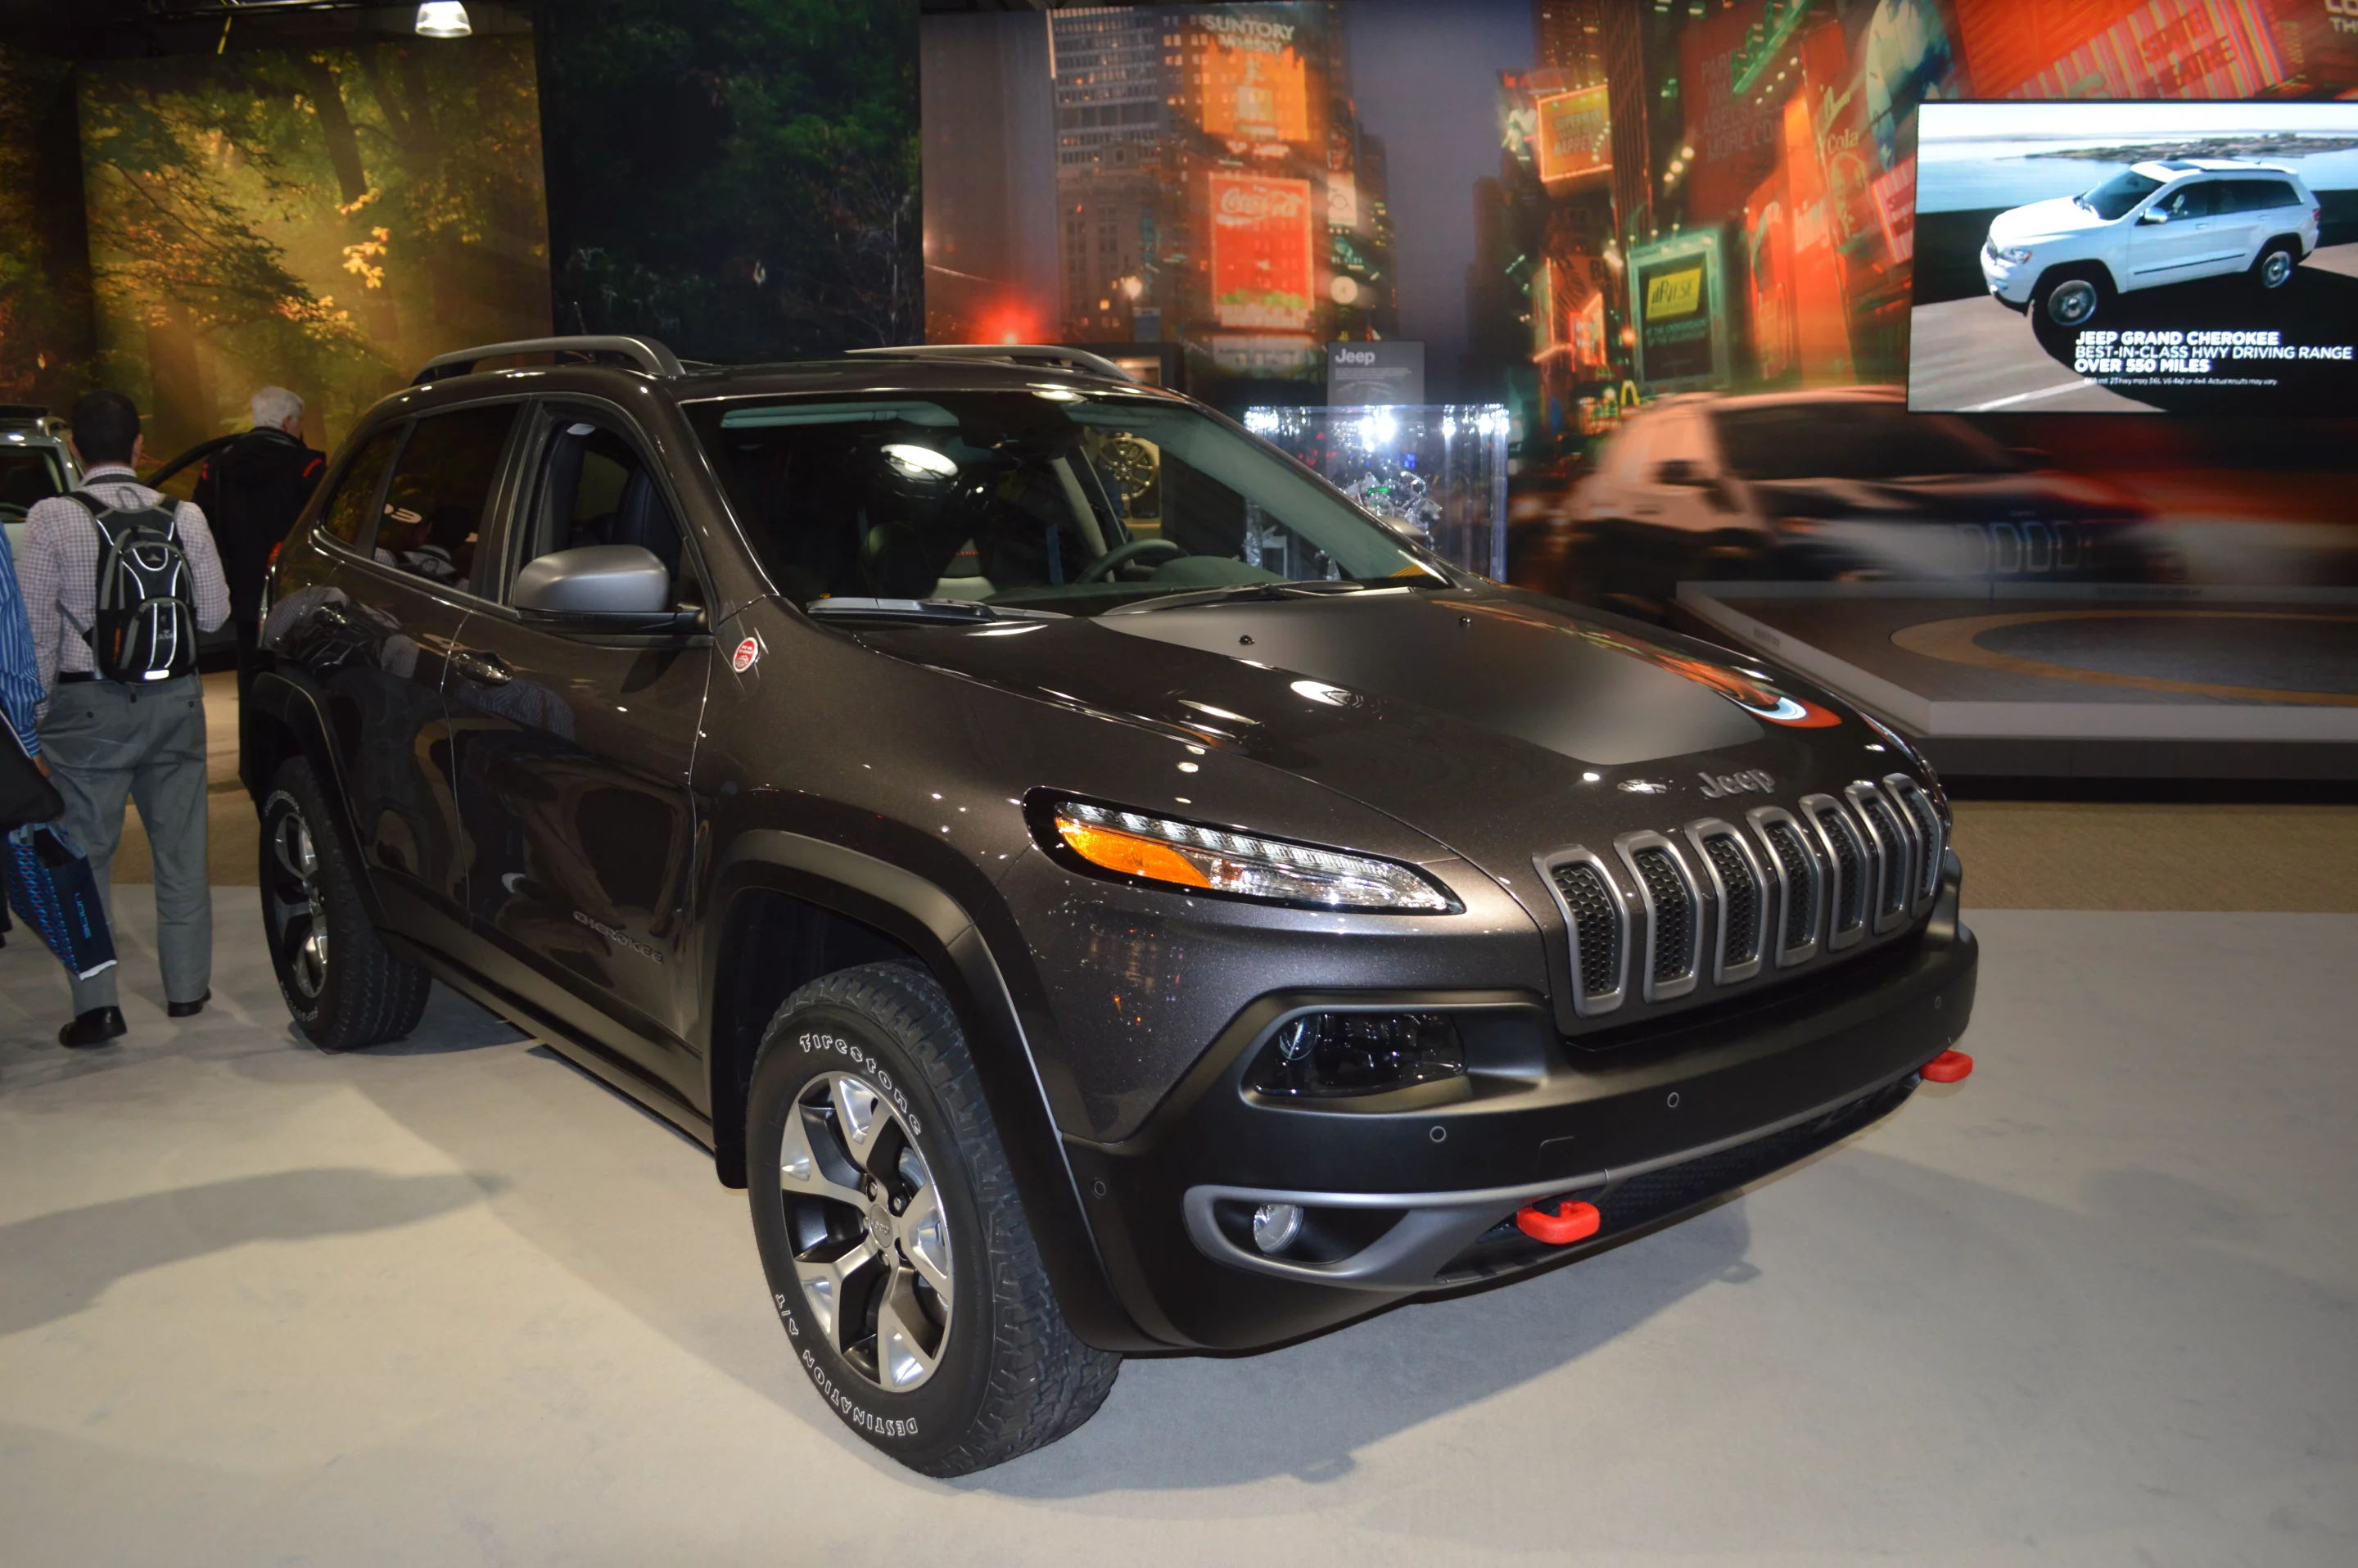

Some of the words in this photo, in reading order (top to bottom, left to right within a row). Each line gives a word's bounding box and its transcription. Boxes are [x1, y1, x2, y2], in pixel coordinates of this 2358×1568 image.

[1205, 13, 1294, 41] SUNTORY
[1827, 128, 1859, 155] Cola
[2076, 331, 2117, 346] JEEP
[2121, 331, 2183, 346] GRAND
[2186, 331, 2279, 346] CHEROKEE
[1335, 348, 1376, 366] Jeep
[2075, 346, 2189, 359] BEST-IN-CLASS
[2191, 346, 2229, 359] HWY
[2232, 346, 2295, 359] DRIVING
[2298, 346, 2353, 360] RANGE
[2074, 359, 2121, 373] OVER
[2125, 359, 2156, 373] 550
[2160, 359, 2210, 373] MILES
[1696, 768, 1776, 798] Jeep
[802, 1349, 919, 1436] DESTINATION
